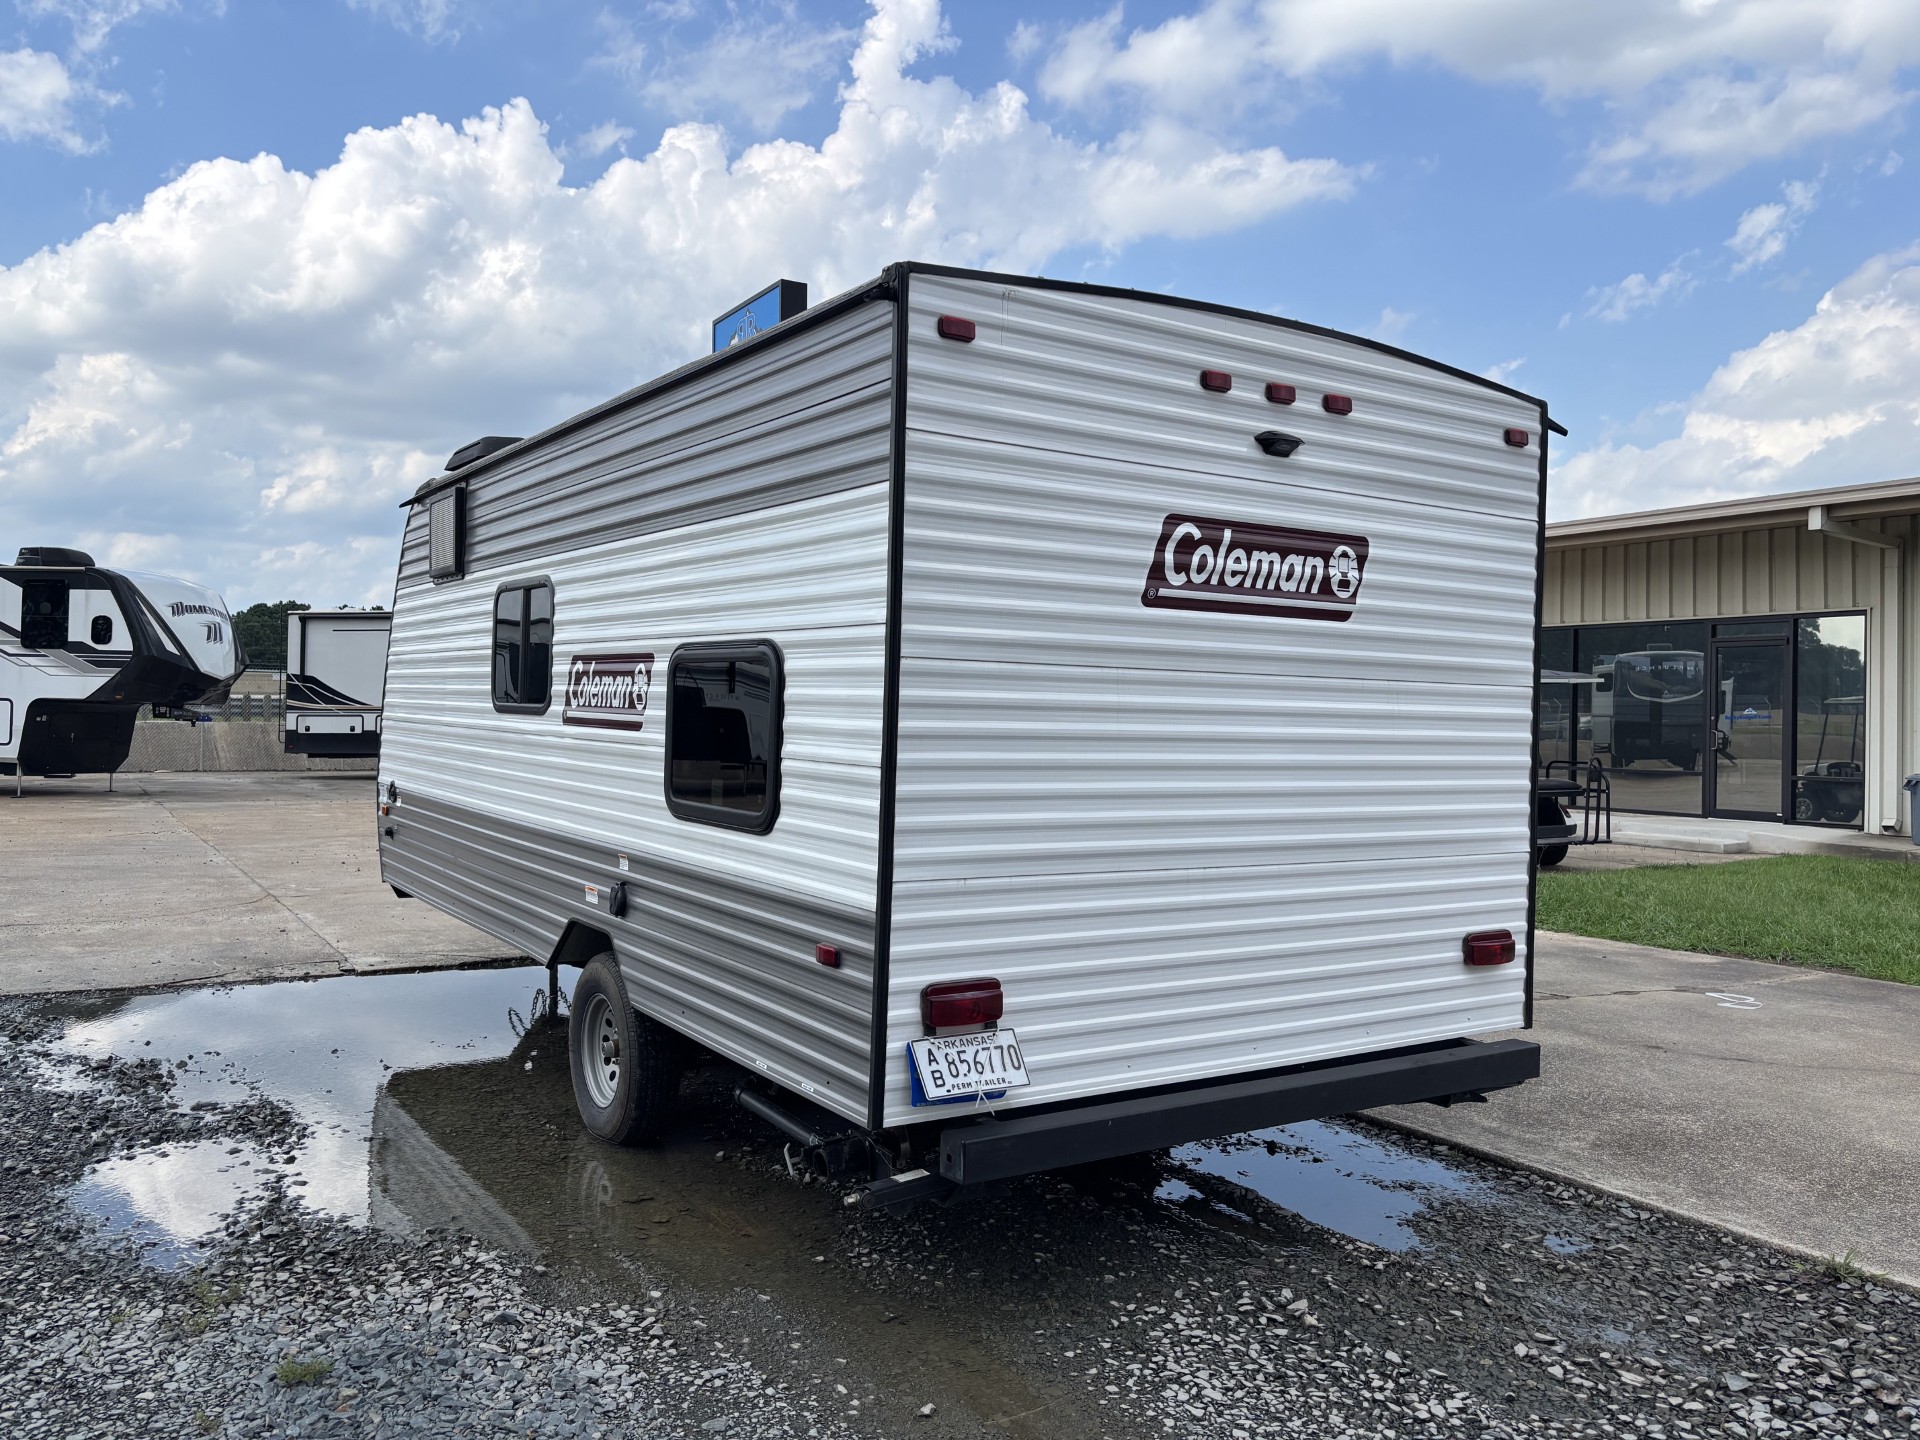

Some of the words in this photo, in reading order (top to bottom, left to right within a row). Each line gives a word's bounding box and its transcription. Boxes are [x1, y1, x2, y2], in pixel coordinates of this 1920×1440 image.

[1164, 522, 1325, 594] Coleman
[569, 660, 633, 709] Coleman
[937, 1035, 996, 1051] ARKANSAS
[945, 1044, 1022, 1078] 856770
[951, 1081, 973, 1091] PERM
[975, 1077, 1007, 1087] TAILER
